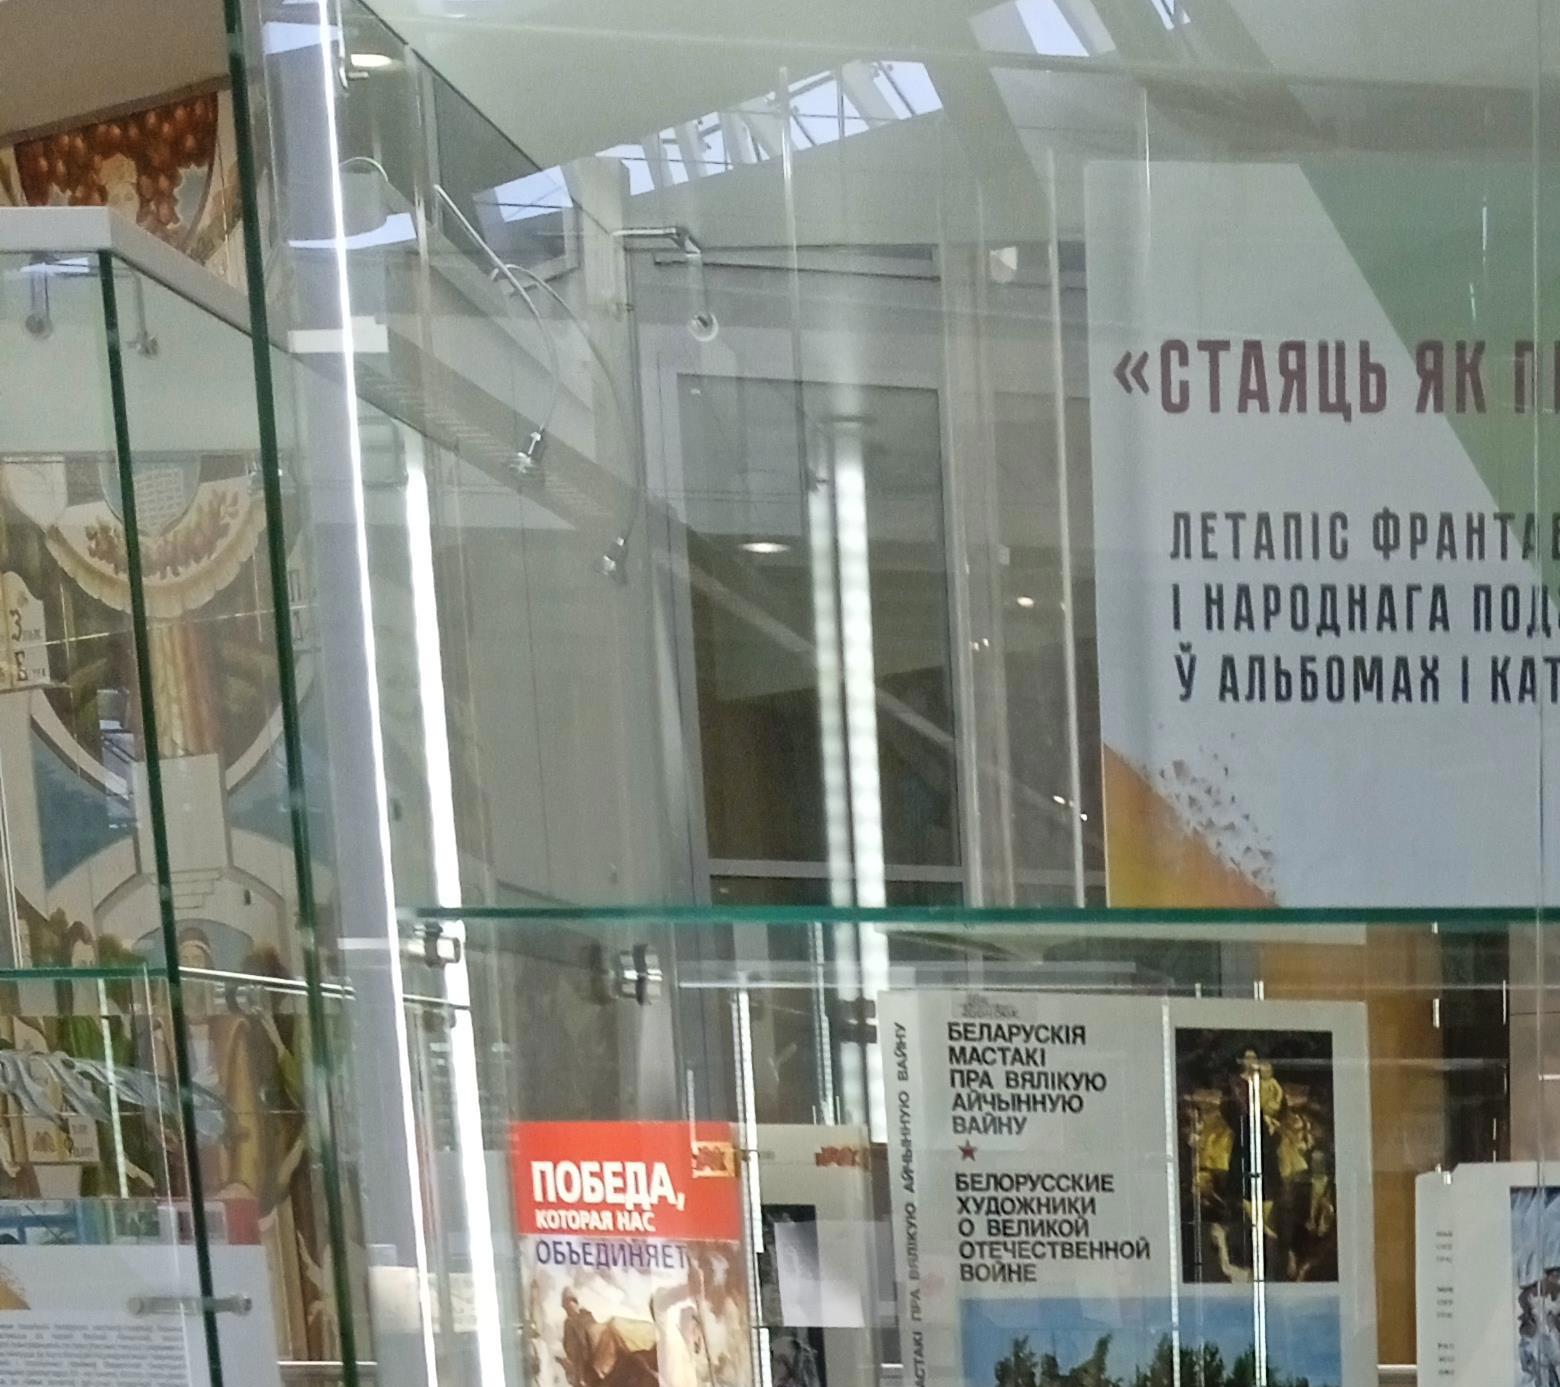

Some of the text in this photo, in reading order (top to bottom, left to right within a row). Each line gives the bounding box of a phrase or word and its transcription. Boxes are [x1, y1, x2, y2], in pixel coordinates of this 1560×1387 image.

[1114, 339, 1389, 422] «СТАЯЦЬ
[1416, 340, 1487, 414] ЯК
[1171, 512, 1348, 561] ЛЕТАПІС
[1172, 584, 1180, 632] І
[1204, 584, 1450, 637] НАРОДНАГА
[1174, 642, 1197, 702] Ў
[1218, 654, 1440, 704] АЛЬБОМАХ
[1461, 655, 1470, 703] І
[948, 1021, 1086, 1046] БЕЛАРУСКІЯ
[893, 1022, 909, 1082] ВАЙНУ
[948, 1045, 1046, 1067] МАСТАКІ
[950, 1069, 1107, 1092] ПРА ВЯЛІКУЮ
[952, 1089, 1084, 1113] АЙЧЫННУЮ
[952, 1112, 1027, 1136] ВАЙНУ
[898, 1091, 916, 1194] АЙЧЫННУЮ
[531, 1160, 686, 1211] ПОБЕДА,
[955, 1172, 1115, 1194] БЕЛОРУССКИЕ
[956, 1196, 1097, 1217] ХУДОЖНИКИ
[535, 1208, 656, 1232] КОТОРАЯ НАС
[958, 1215, 1089, 1238] О ВЕЛИКОЙ
[904, 1202, 921, 1281] ВЯЛІКУЮ
[958, 1236, 1151, 1260] ОТЕЧЕСТВЕННОЙ
[536, 1239, 688, 1271] ОБЪЕДИНЯЕТ
[960, 1259, 1038, 1283] ВОЙНЕ
[910, 1288, 923, 1322] ПРА
